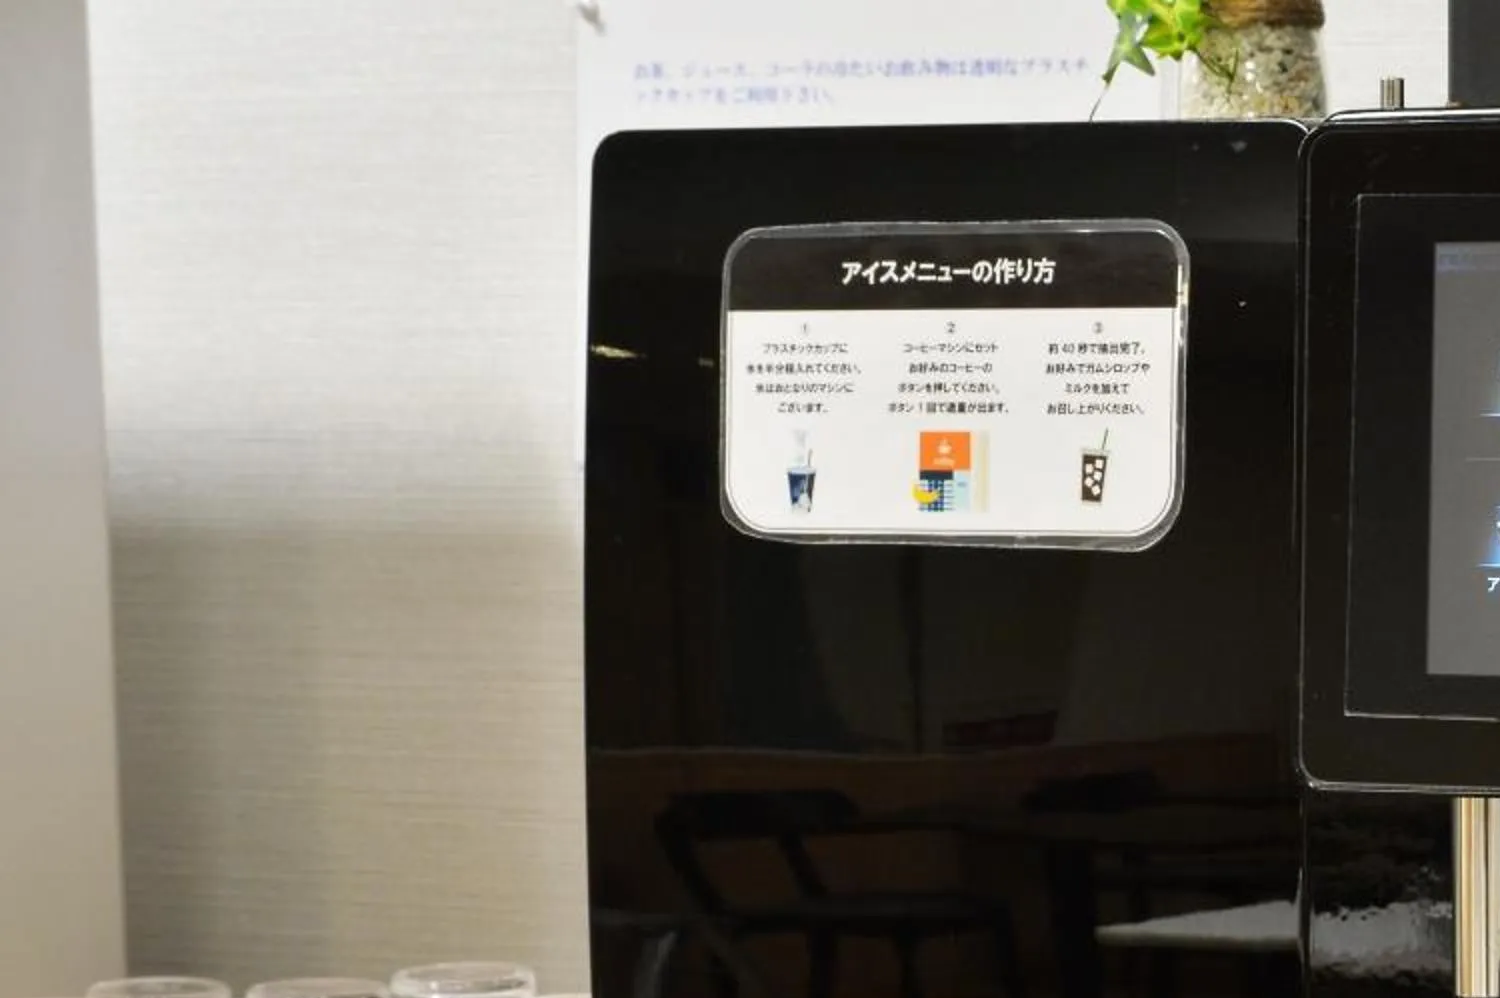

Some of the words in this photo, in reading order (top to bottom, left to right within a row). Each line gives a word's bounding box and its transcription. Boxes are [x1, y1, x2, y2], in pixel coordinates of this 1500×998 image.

[841, 258, 1056, 285] アイスメニューの作り方
[946, 321, 955, 333] 2
[762, 343, 848, 354] プラスチックカップに
[902, 342, 999, 354] コーヒーマシンにセット
[909, 362, 992, 374] お好みのコーヒーの
[1046, 362, 1151, 375] お好みでガムシロップや
[898, 382, 1001, 394] ボタンを押してください。
[1065, 382, 1130, 395] ミルクを加えて
